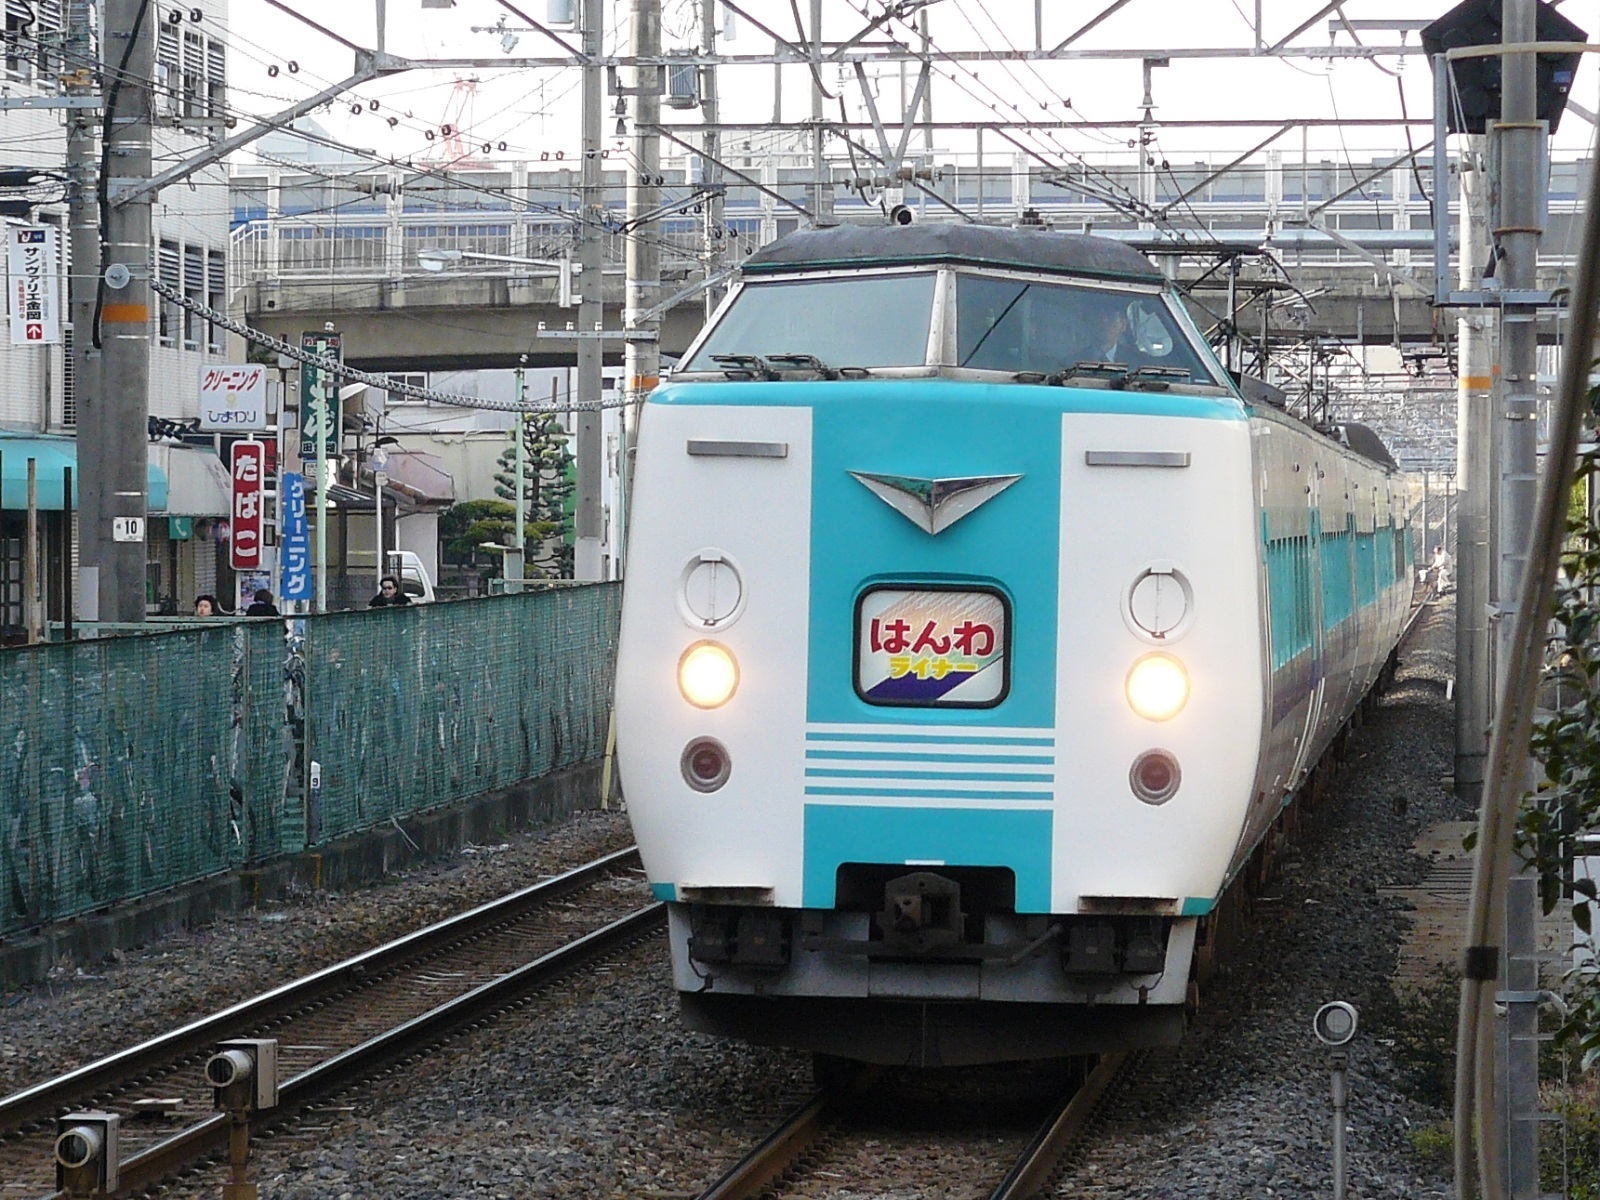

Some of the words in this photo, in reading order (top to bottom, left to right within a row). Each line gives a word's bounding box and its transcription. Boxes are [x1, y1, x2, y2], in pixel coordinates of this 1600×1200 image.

[203, 369, 262, 391] クリーニング
[207, 410, 257, 423] ひまわり
[235, 455, 260, 557] たばこ
[125, 520, 138, 535] 10
[287, 480, 307, 594] クリーニング
[870, 618, 995, 656] はんわ
[889, 656, 978, 680] ライナー
[312, 777, 319, 787] 9
